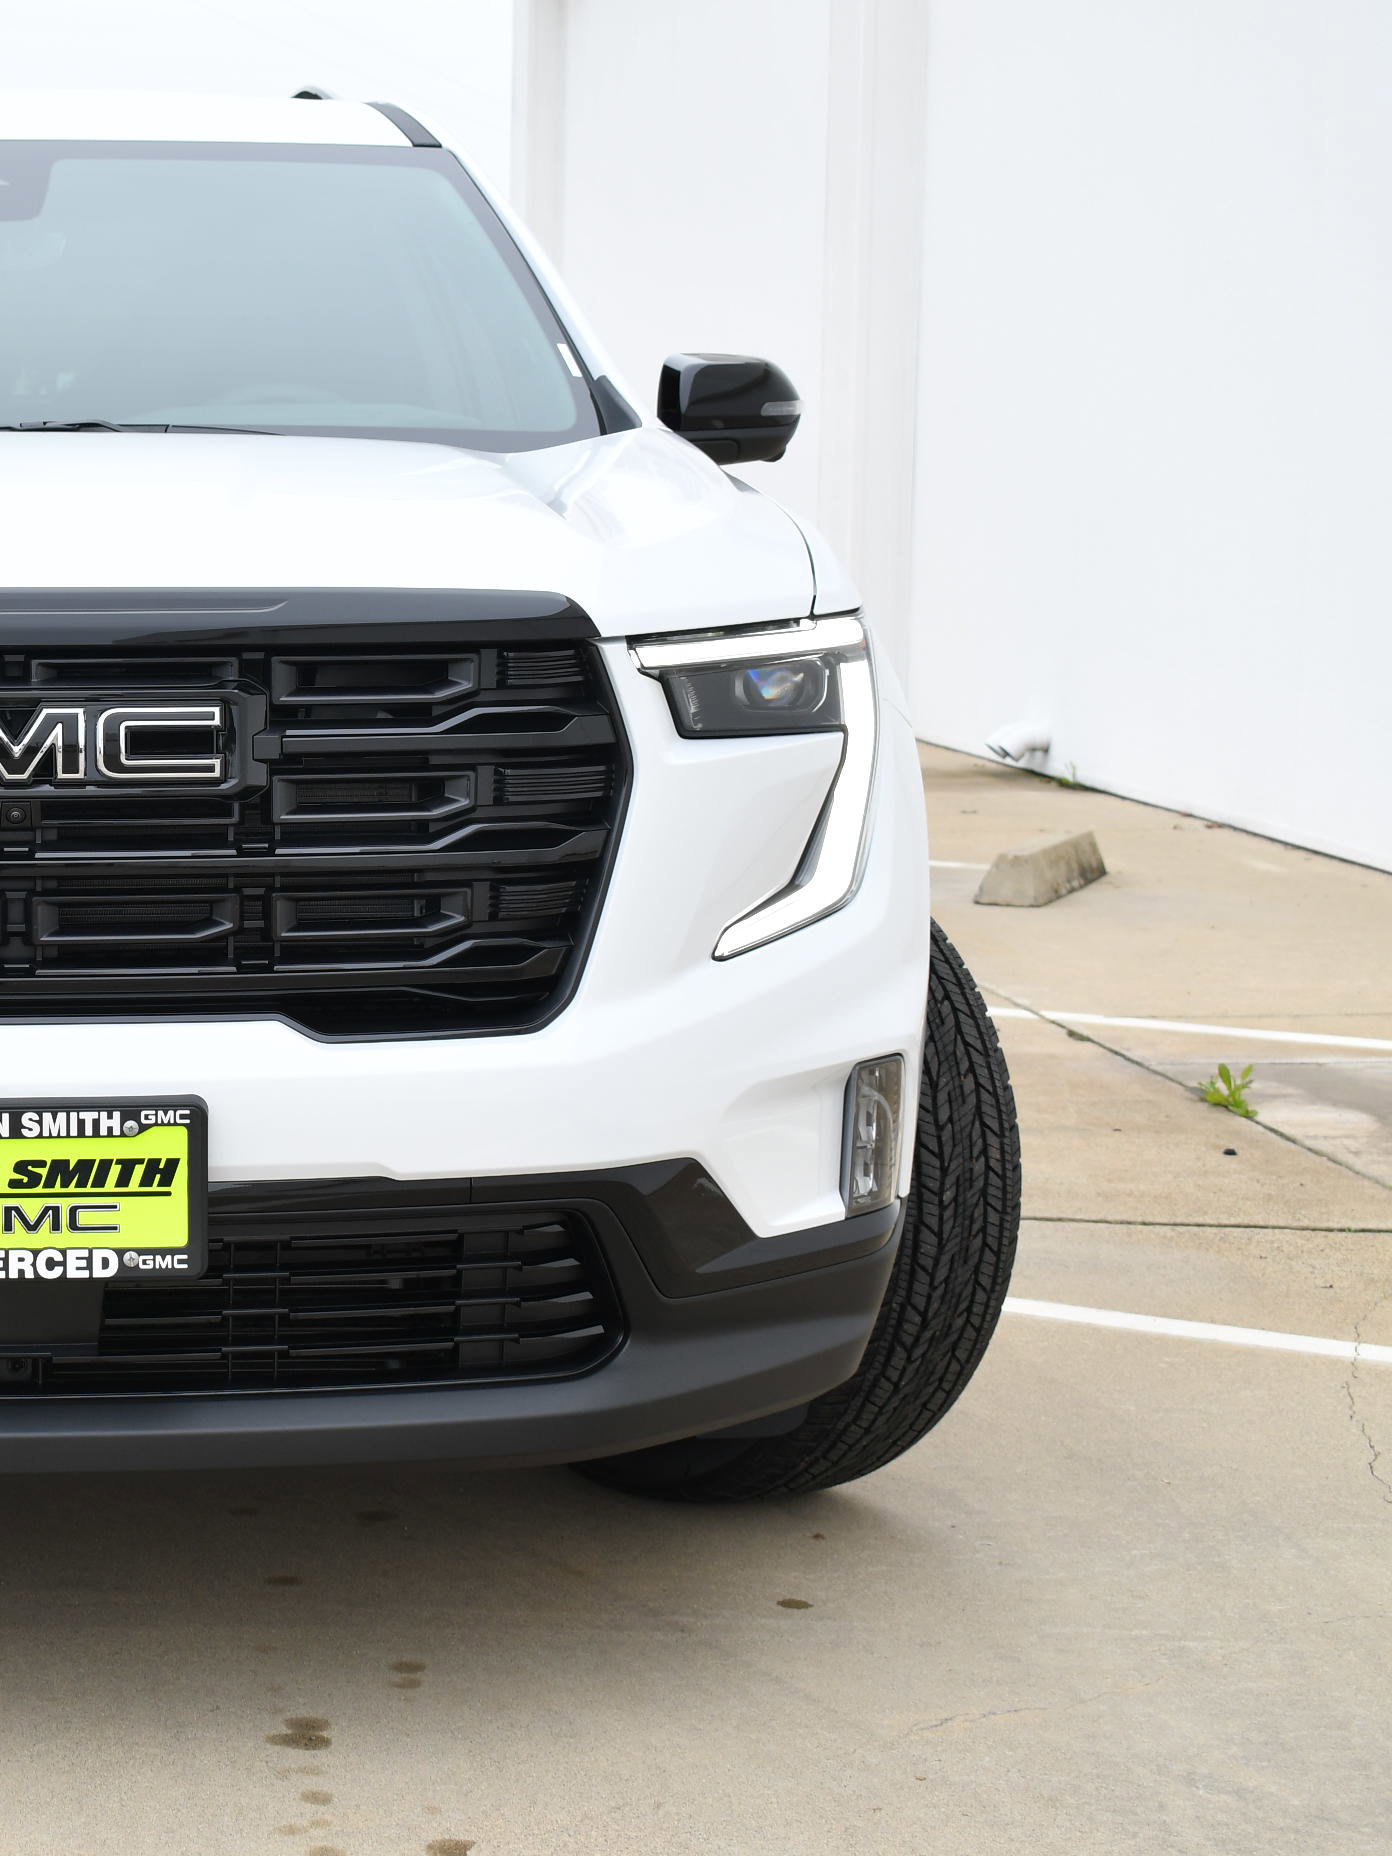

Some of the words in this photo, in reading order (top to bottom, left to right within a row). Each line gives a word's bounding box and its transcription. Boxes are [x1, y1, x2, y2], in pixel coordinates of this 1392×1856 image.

[21, 1111, 121, 1138] SMITH
[140, 1110, 191, 1125] GMC
[8, 1157, 180, 1189] SMITH
[138, 1254, 189, 1269] GMC
